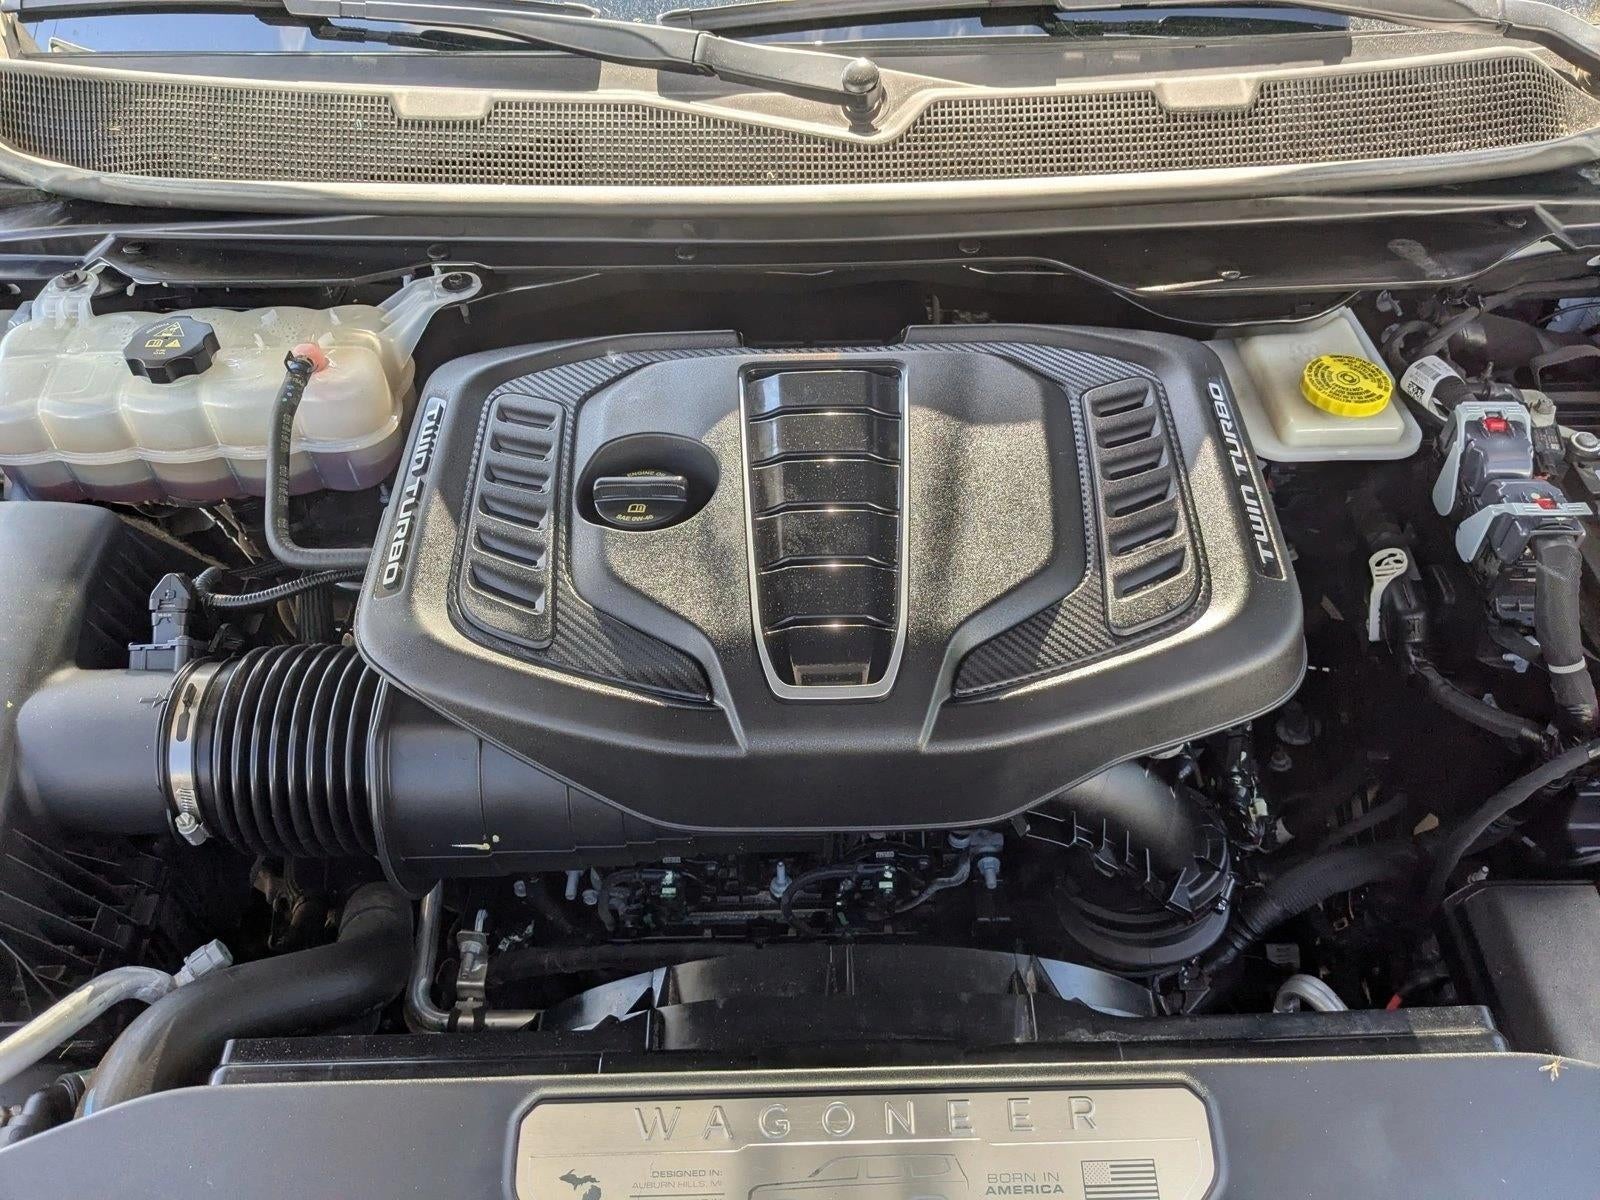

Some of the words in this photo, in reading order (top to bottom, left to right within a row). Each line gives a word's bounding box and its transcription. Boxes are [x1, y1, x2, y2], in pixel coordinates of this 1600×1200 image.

[411, 402, 444, 477] TWIN
[1207, 381, 1248, 477] TURBO
[615, 513, 631, 521] SAE
[1241, 484, 1275, 565] TWIN
[382, 476, 424, 590] TURBO
[634, 1096, 1098, 1141] WAGONEER
[631, 1181, 676, 1190] AUBURN
[677, 1180, 708, 1189] HILLS,
[651, 1169, 706, 1179] DESIGNED
[708, 1168, 723, 1177] IN:
[987, 1172, 1036, 1184] BORN
[1043, 1171, 1060, 1183] IN
[985, 1184, 1065, 1196] AMERICA
